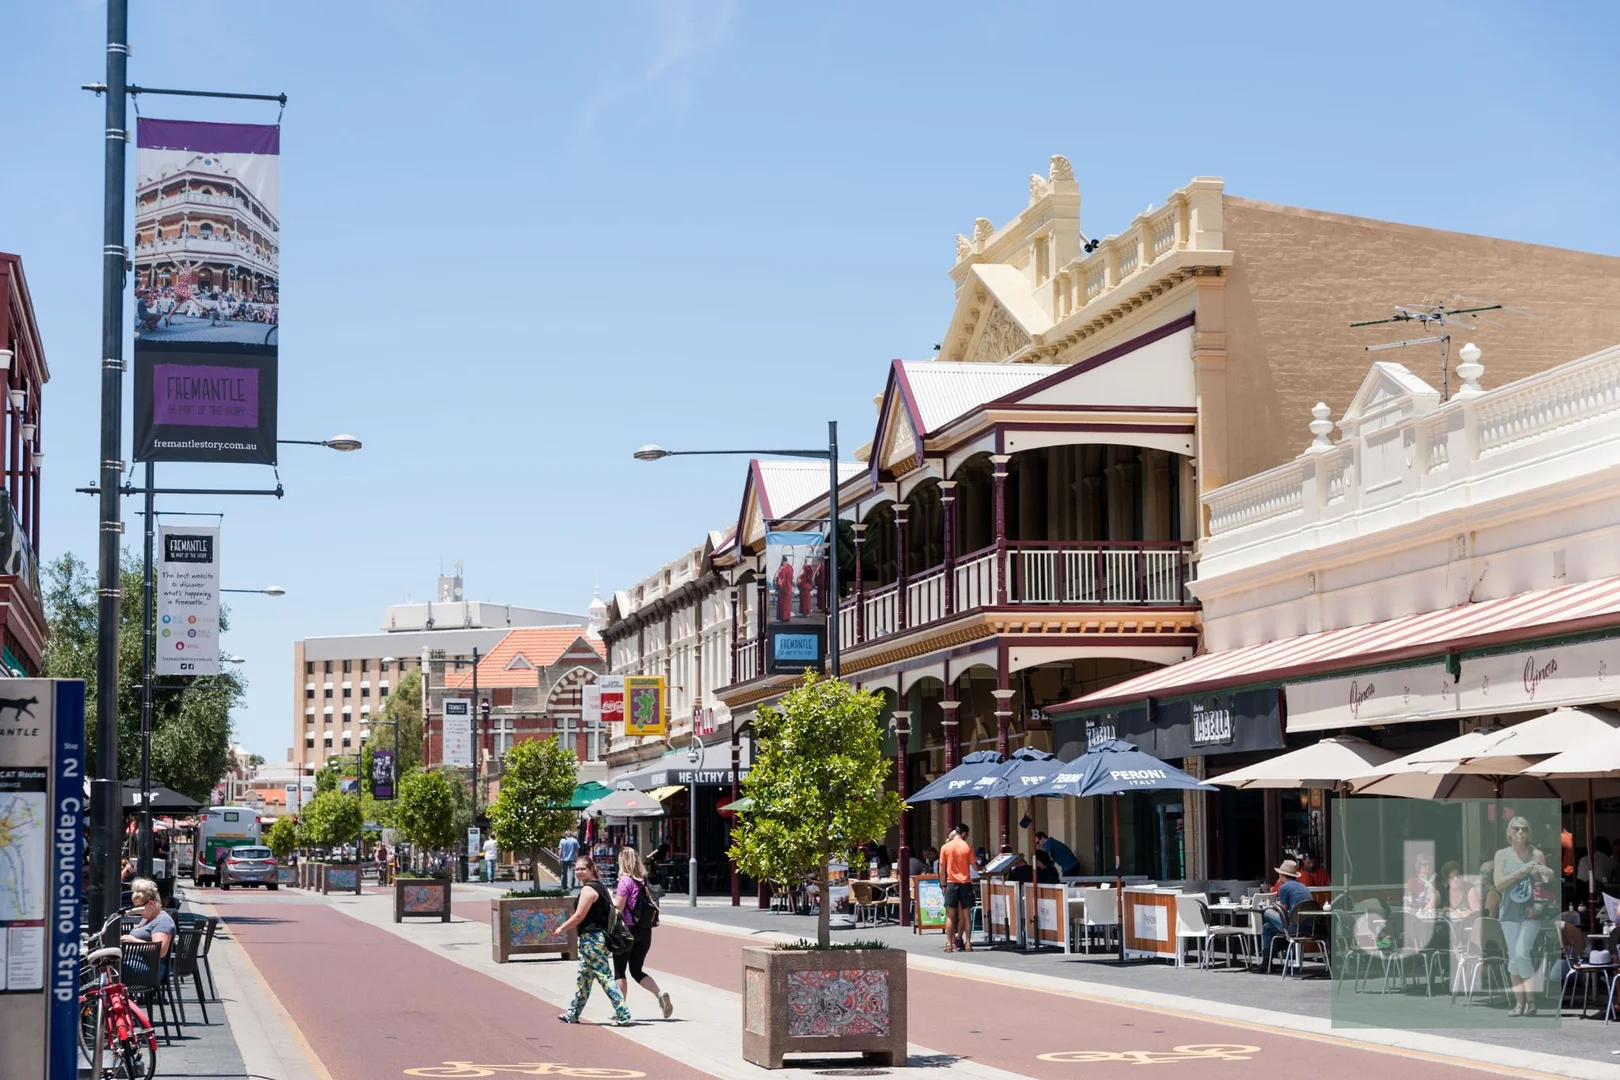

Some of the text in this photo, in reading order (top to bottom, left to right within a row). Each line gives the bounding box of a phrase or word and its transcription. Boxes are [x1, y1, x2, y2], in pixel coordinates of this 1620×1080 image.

[166, 376, 246, 402] FREMANTLE
[153, 439, 257, 451] fremantlestory.com.au
[170, 540, 208, 552] FREMANTLE
[780, 638, 813, 650] FREMANTLE
[64, 742, 79, 750] Stop
[63, 757, 79, 777] 2
[678, 771, 724, 783] HEALTHY
[1109, 769, 1167, 781] PERONI
[54, 797, 81, 1001] Cappuccino Strip
